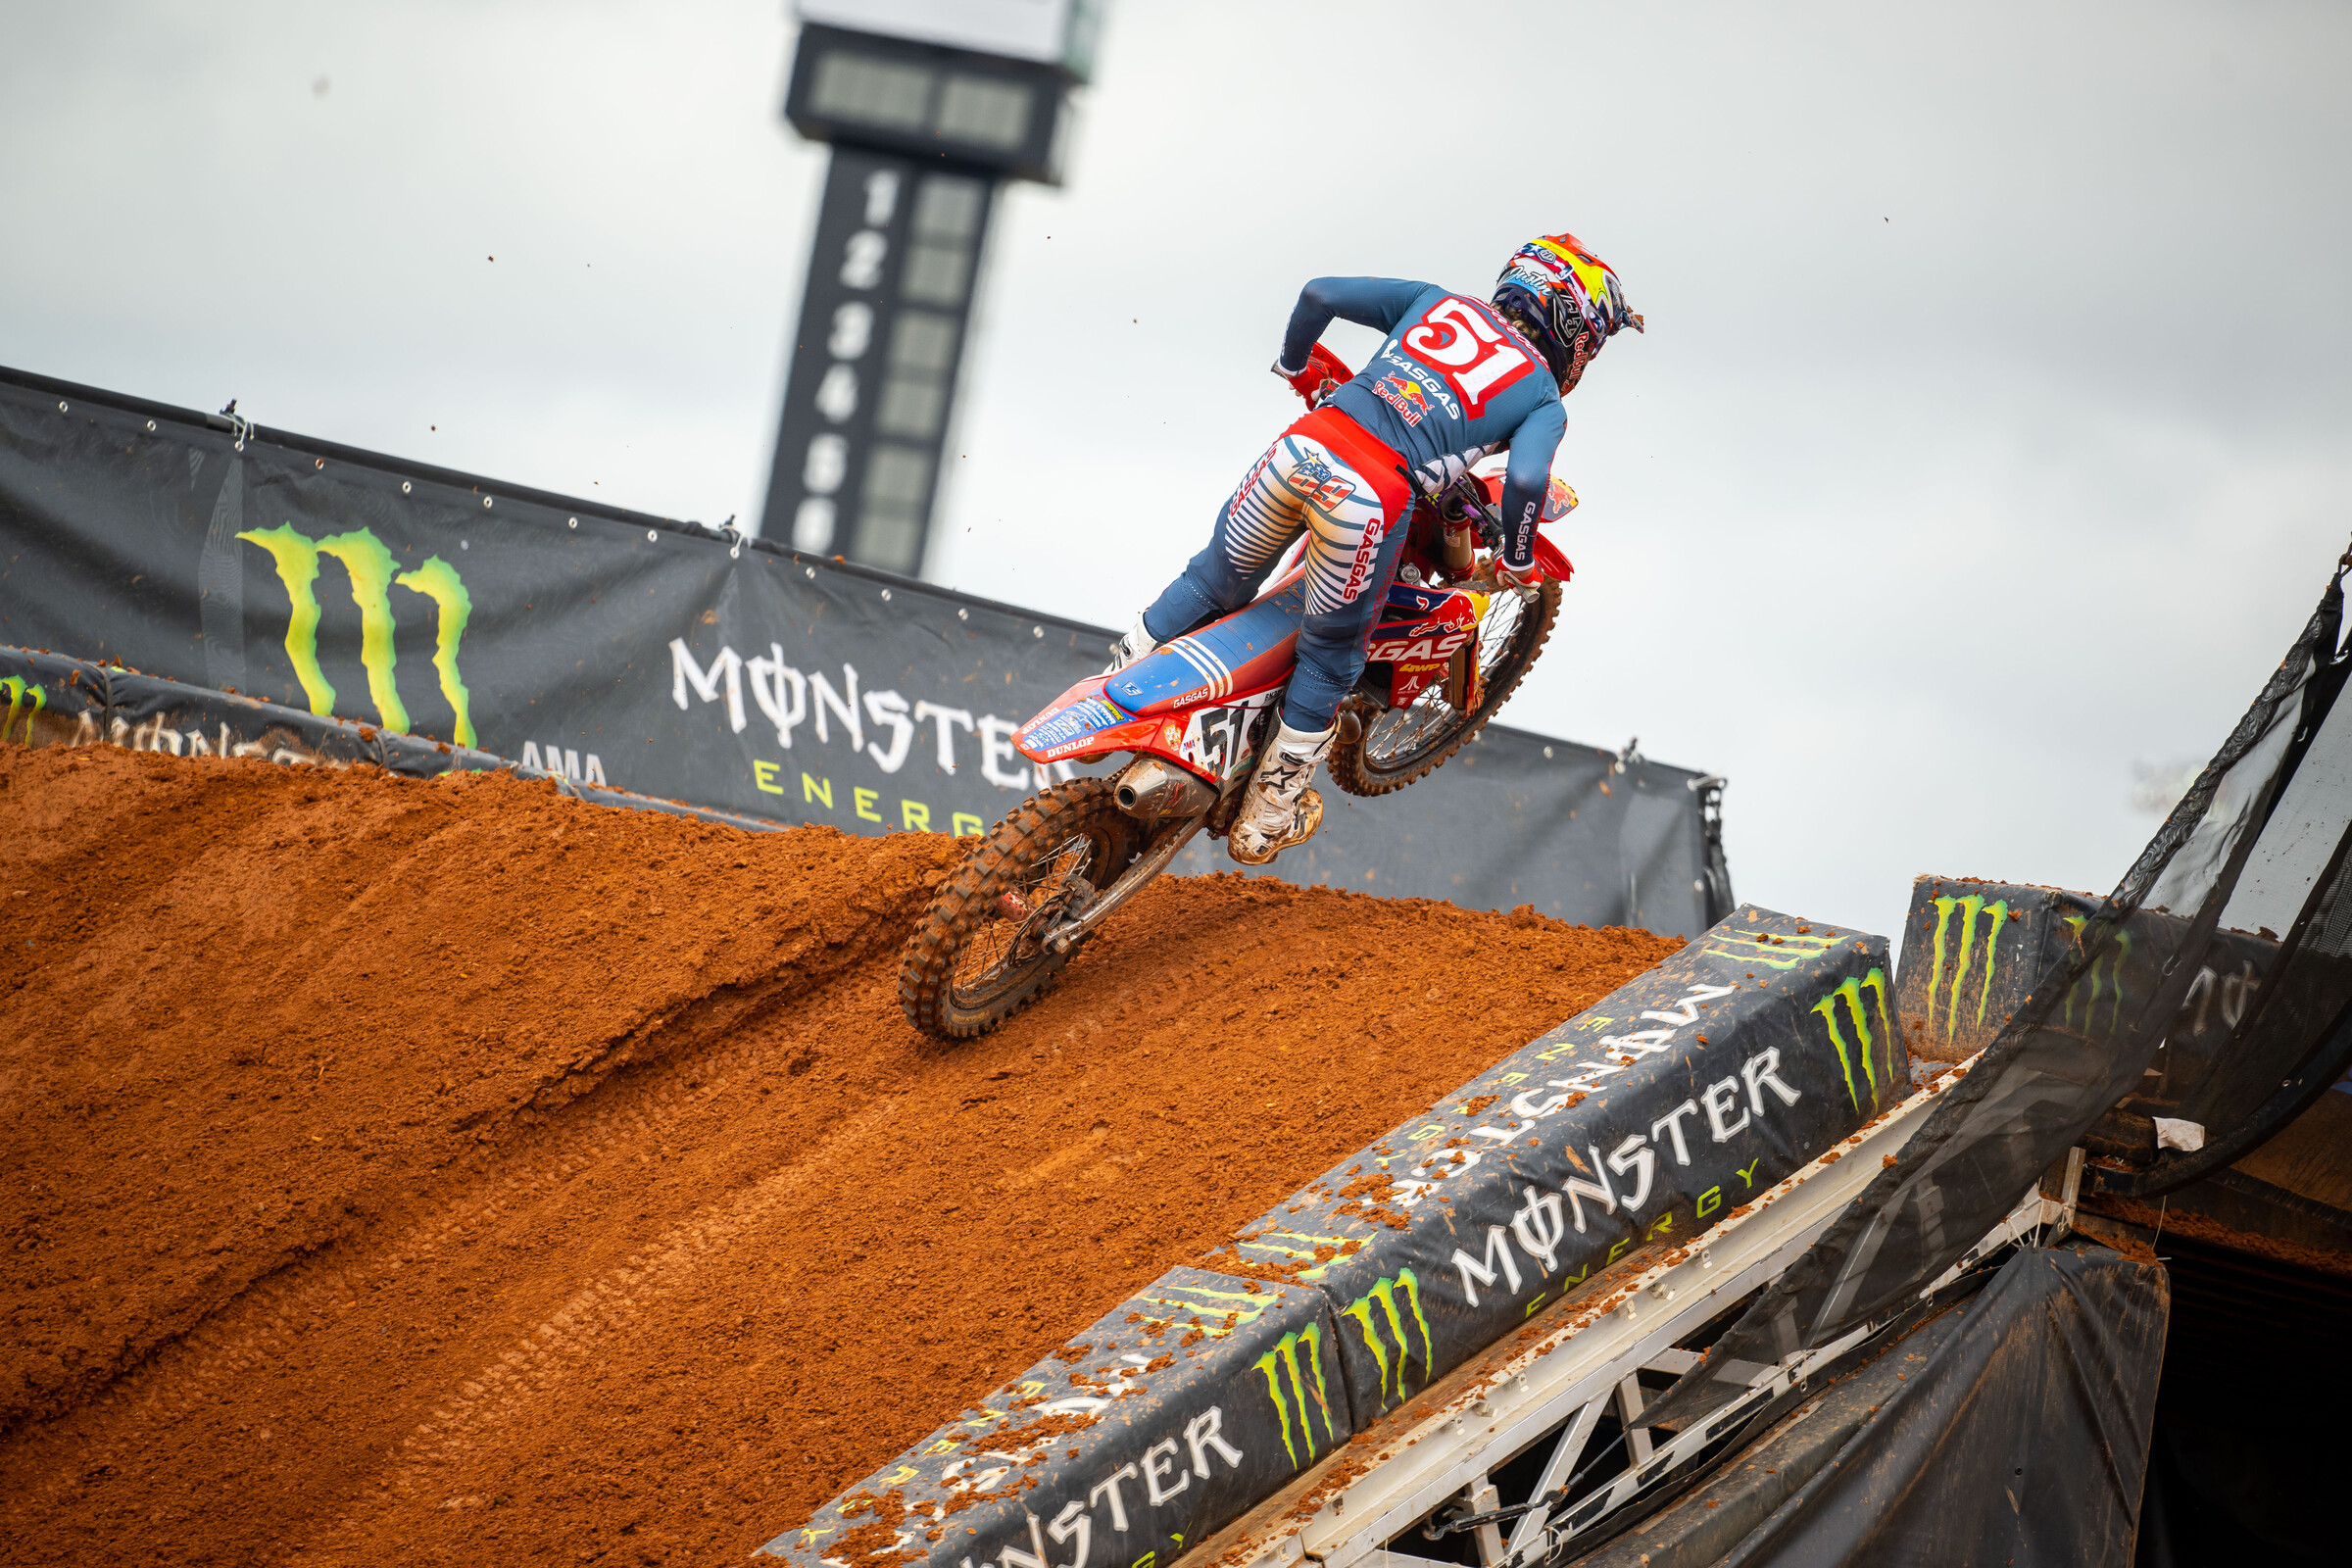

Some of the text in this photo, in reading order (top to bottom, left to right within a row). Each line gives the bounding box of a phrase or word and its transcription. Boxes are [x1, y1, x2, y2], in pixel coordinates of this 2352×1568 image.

[1505, 266, 1552, 296] Justin
[1403, 297, 1532, 412] 51
[1230, 447, 1277, 517] GASGAS
[1343, 517, 1381, 601] GASGAS
[1515, 501, 1537, 561] GASGAS
[1173, 688, 1208, 709] GASGAS
[1047, 737, 1095, 758] DUNLOP
[1200, 700, 1250, 778] 51
[1374, 1015, 1616, 1168] ENEGY
[1525, 1157, 1760, 1319] ENERGY
[959, 1405, 1244, 1568] NSTER
